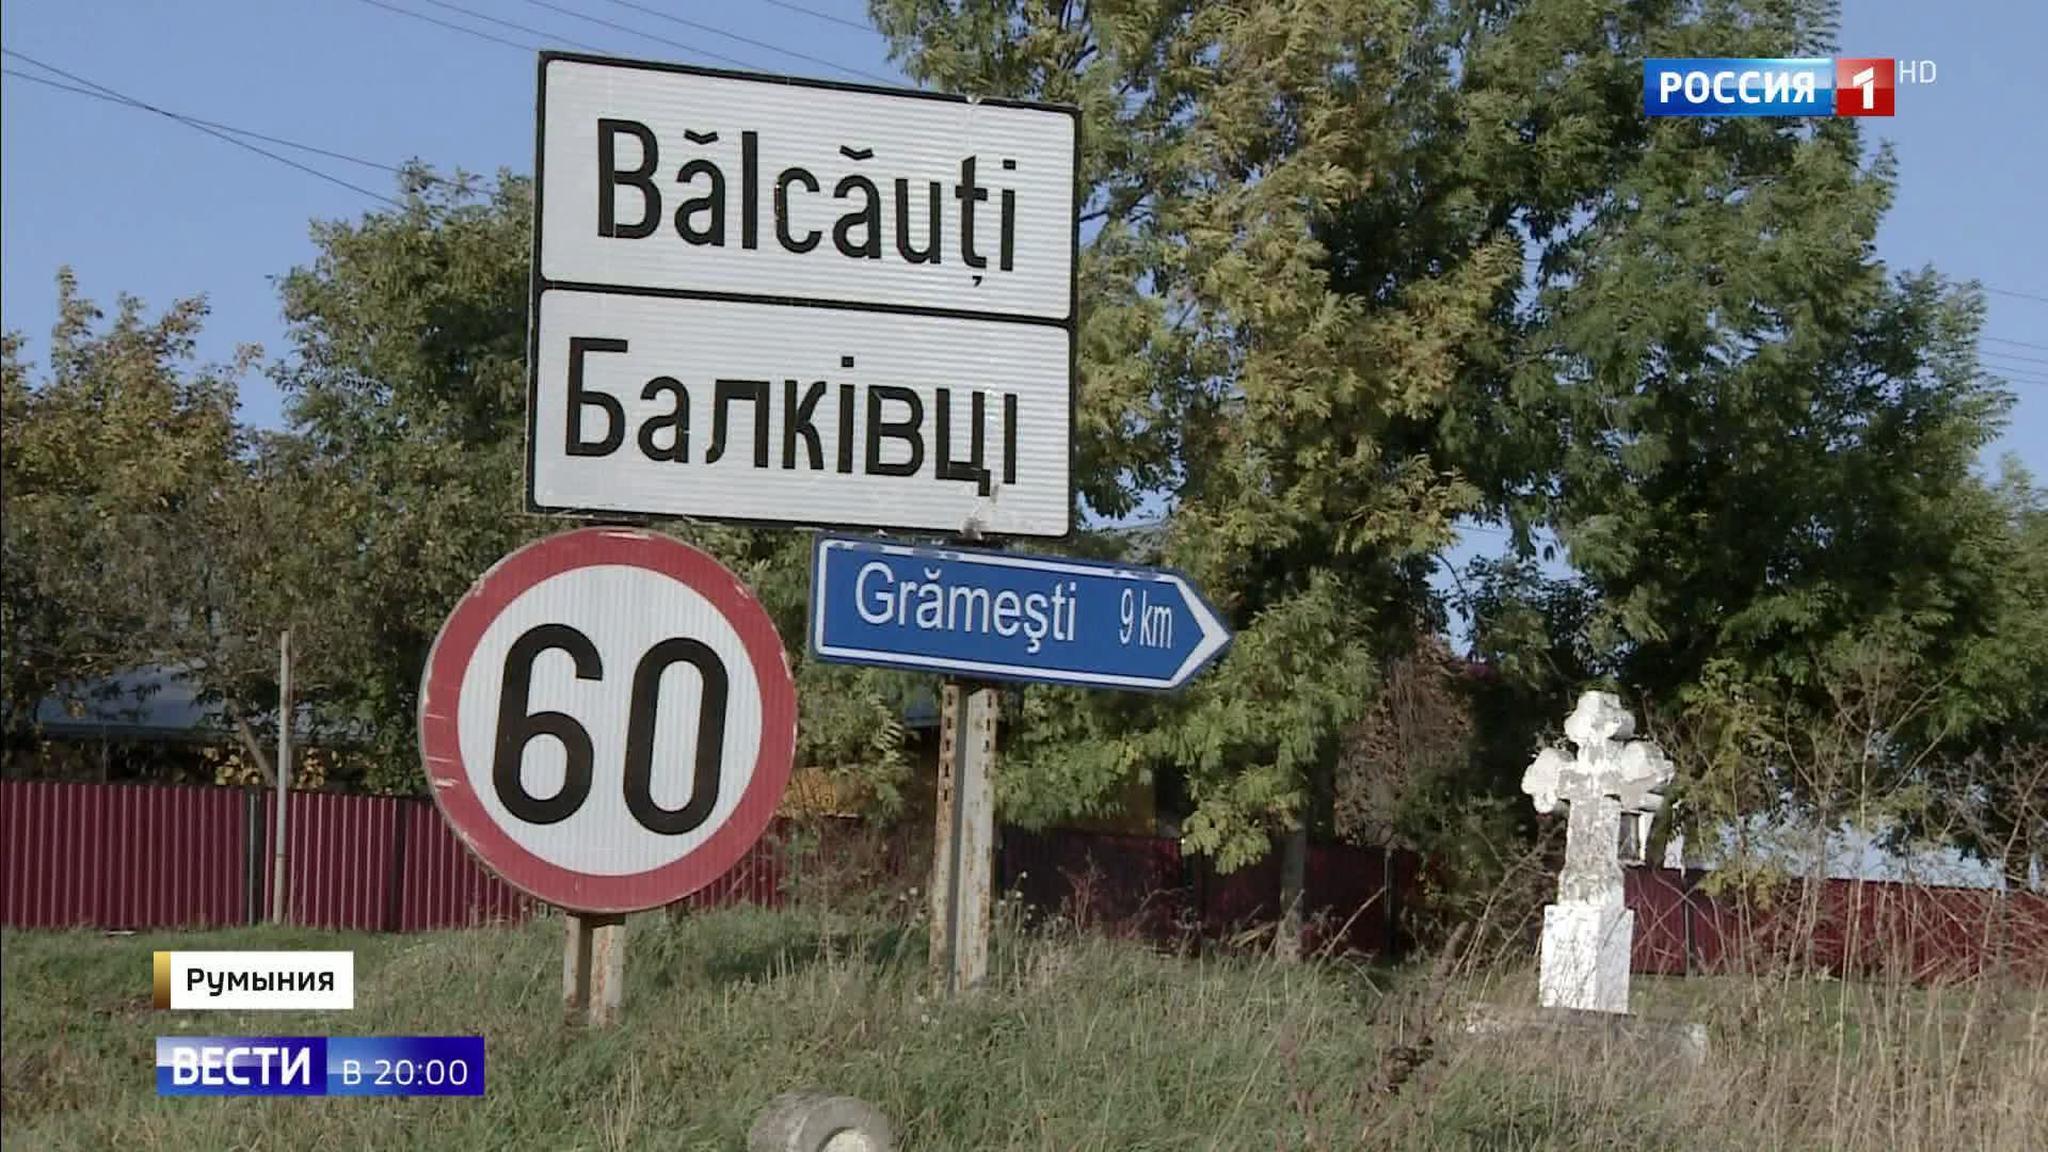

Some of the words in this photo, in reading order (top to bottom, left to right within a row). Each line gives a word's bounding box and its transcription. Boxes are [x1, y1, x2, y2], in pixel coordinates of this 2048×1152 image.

[1119, 587, 1134, 645] 9
[1139, 590, 1174, 650] km
[492, 623, 729, 836] 60
